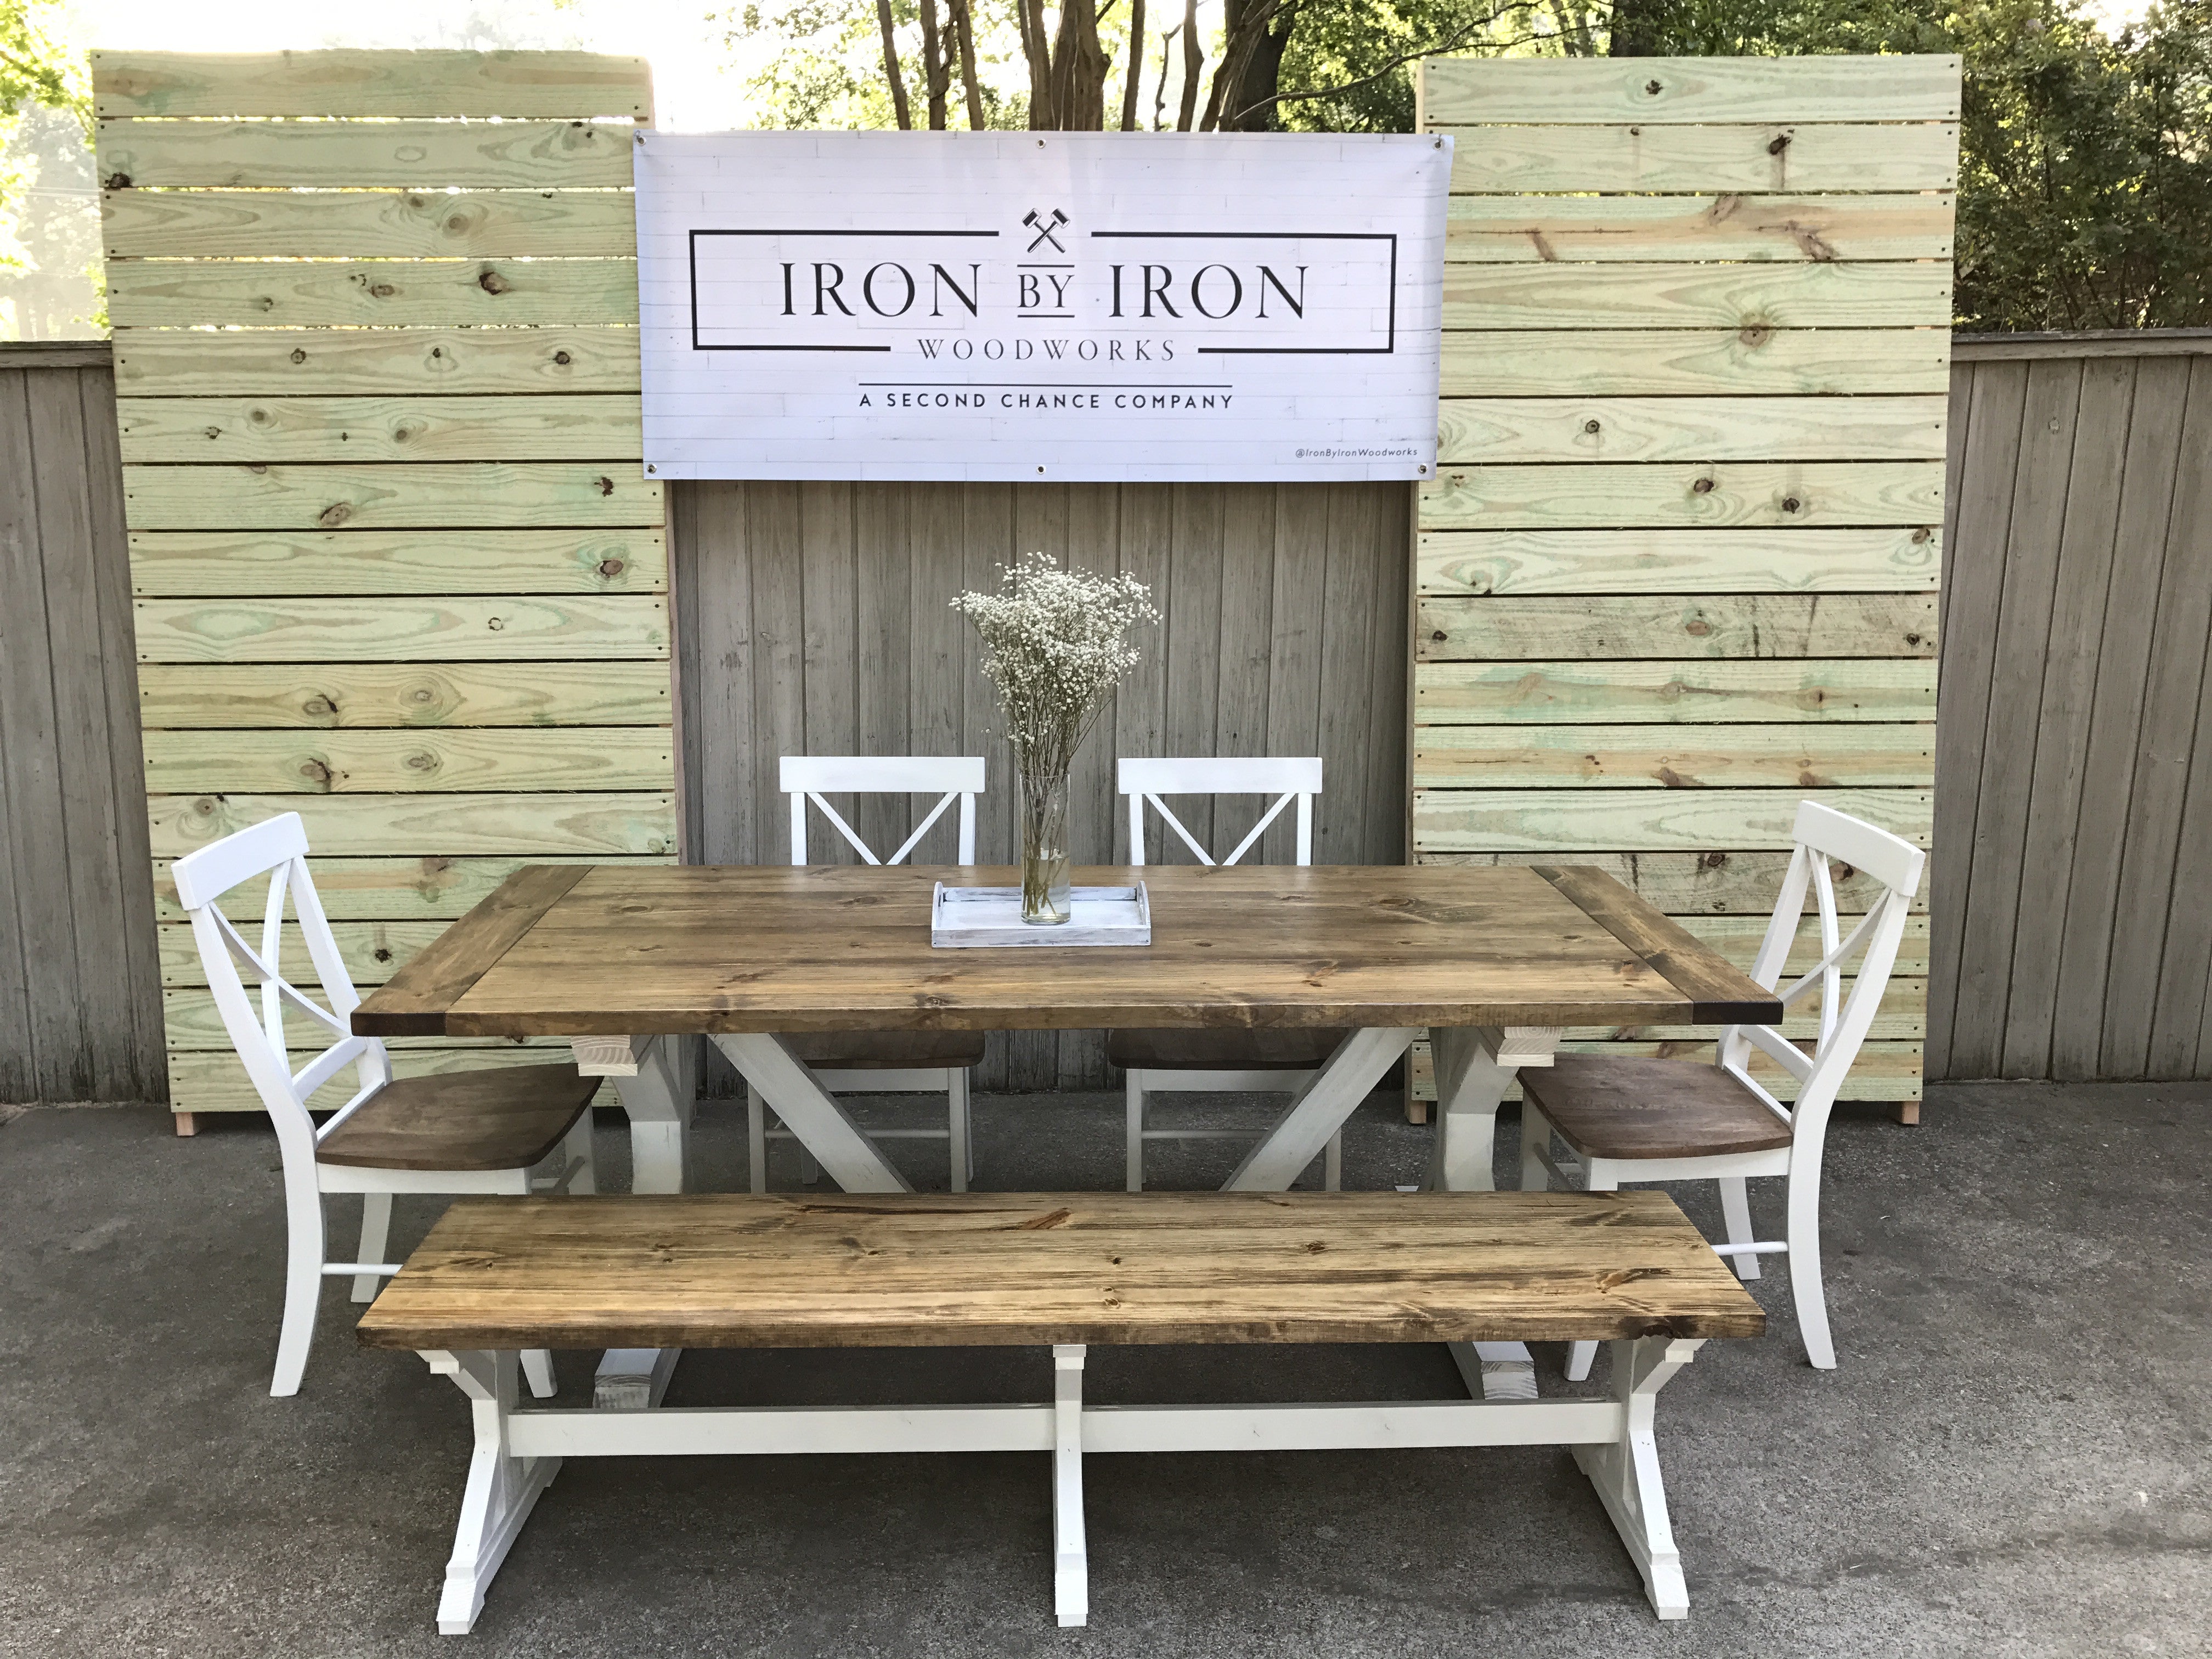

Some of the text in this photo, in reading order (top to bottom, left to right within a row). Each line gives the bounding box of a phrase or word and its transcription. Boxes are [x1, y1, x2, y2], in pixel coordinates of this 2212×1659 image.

[779, 262, 1309, 319] IRON BY IRON
[916, 338, 1174, 361] WOODWORKS
[859, 393, 1233, 409] A SECOND CHANCE COMPANY
[1295, 447, 1418, 459] @IronByIronWoodworks
